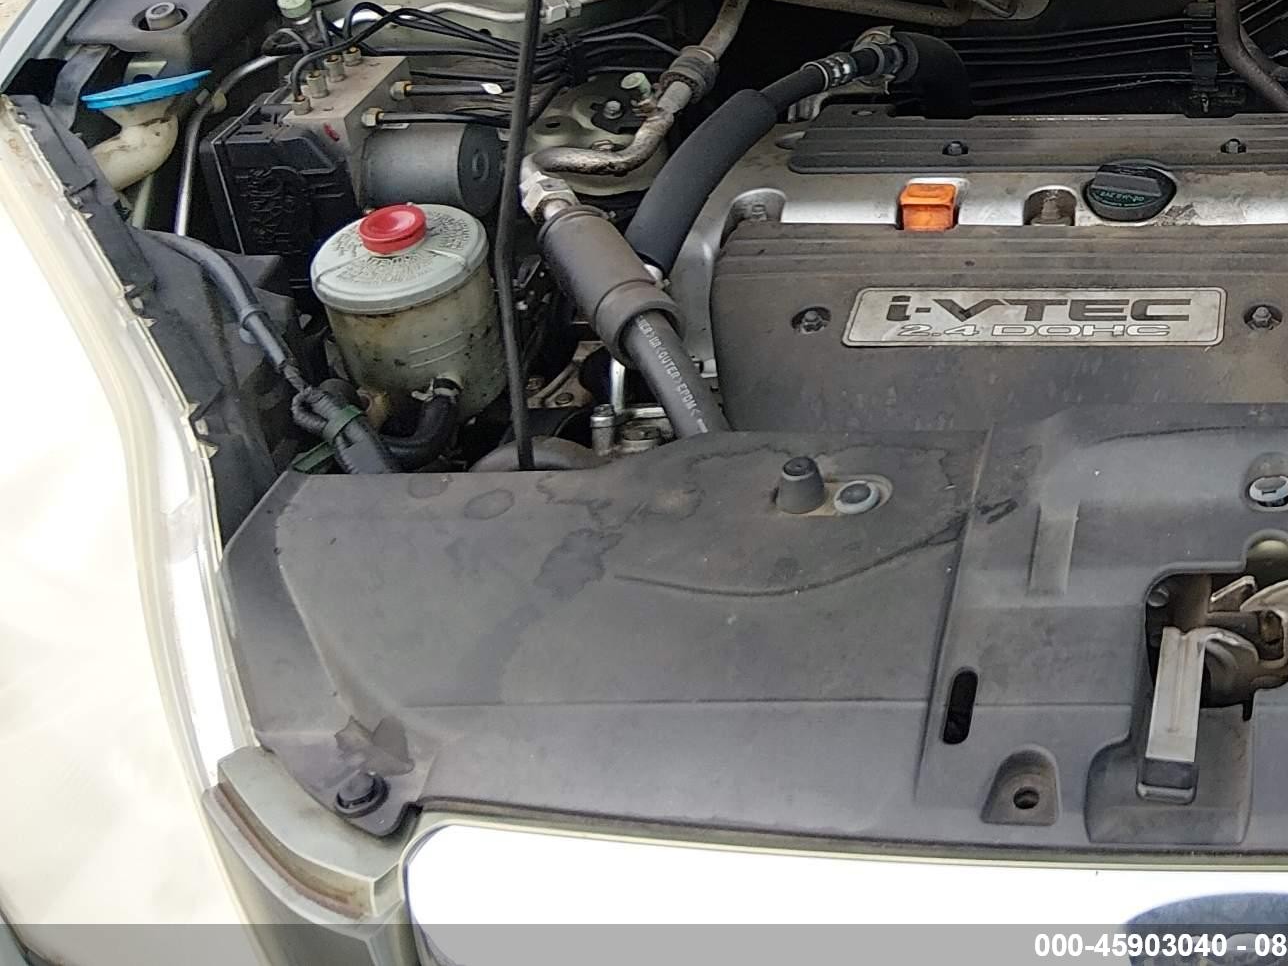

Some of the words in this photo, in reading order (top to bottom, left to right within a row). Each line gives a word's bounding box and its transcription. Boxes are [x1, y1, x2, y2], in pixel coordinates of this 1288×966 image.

[886, 295, 1192, 323] i-VTEC
[899, 323, 980, 337] 2.4
[990, 323, 1171, 337] DOHC
